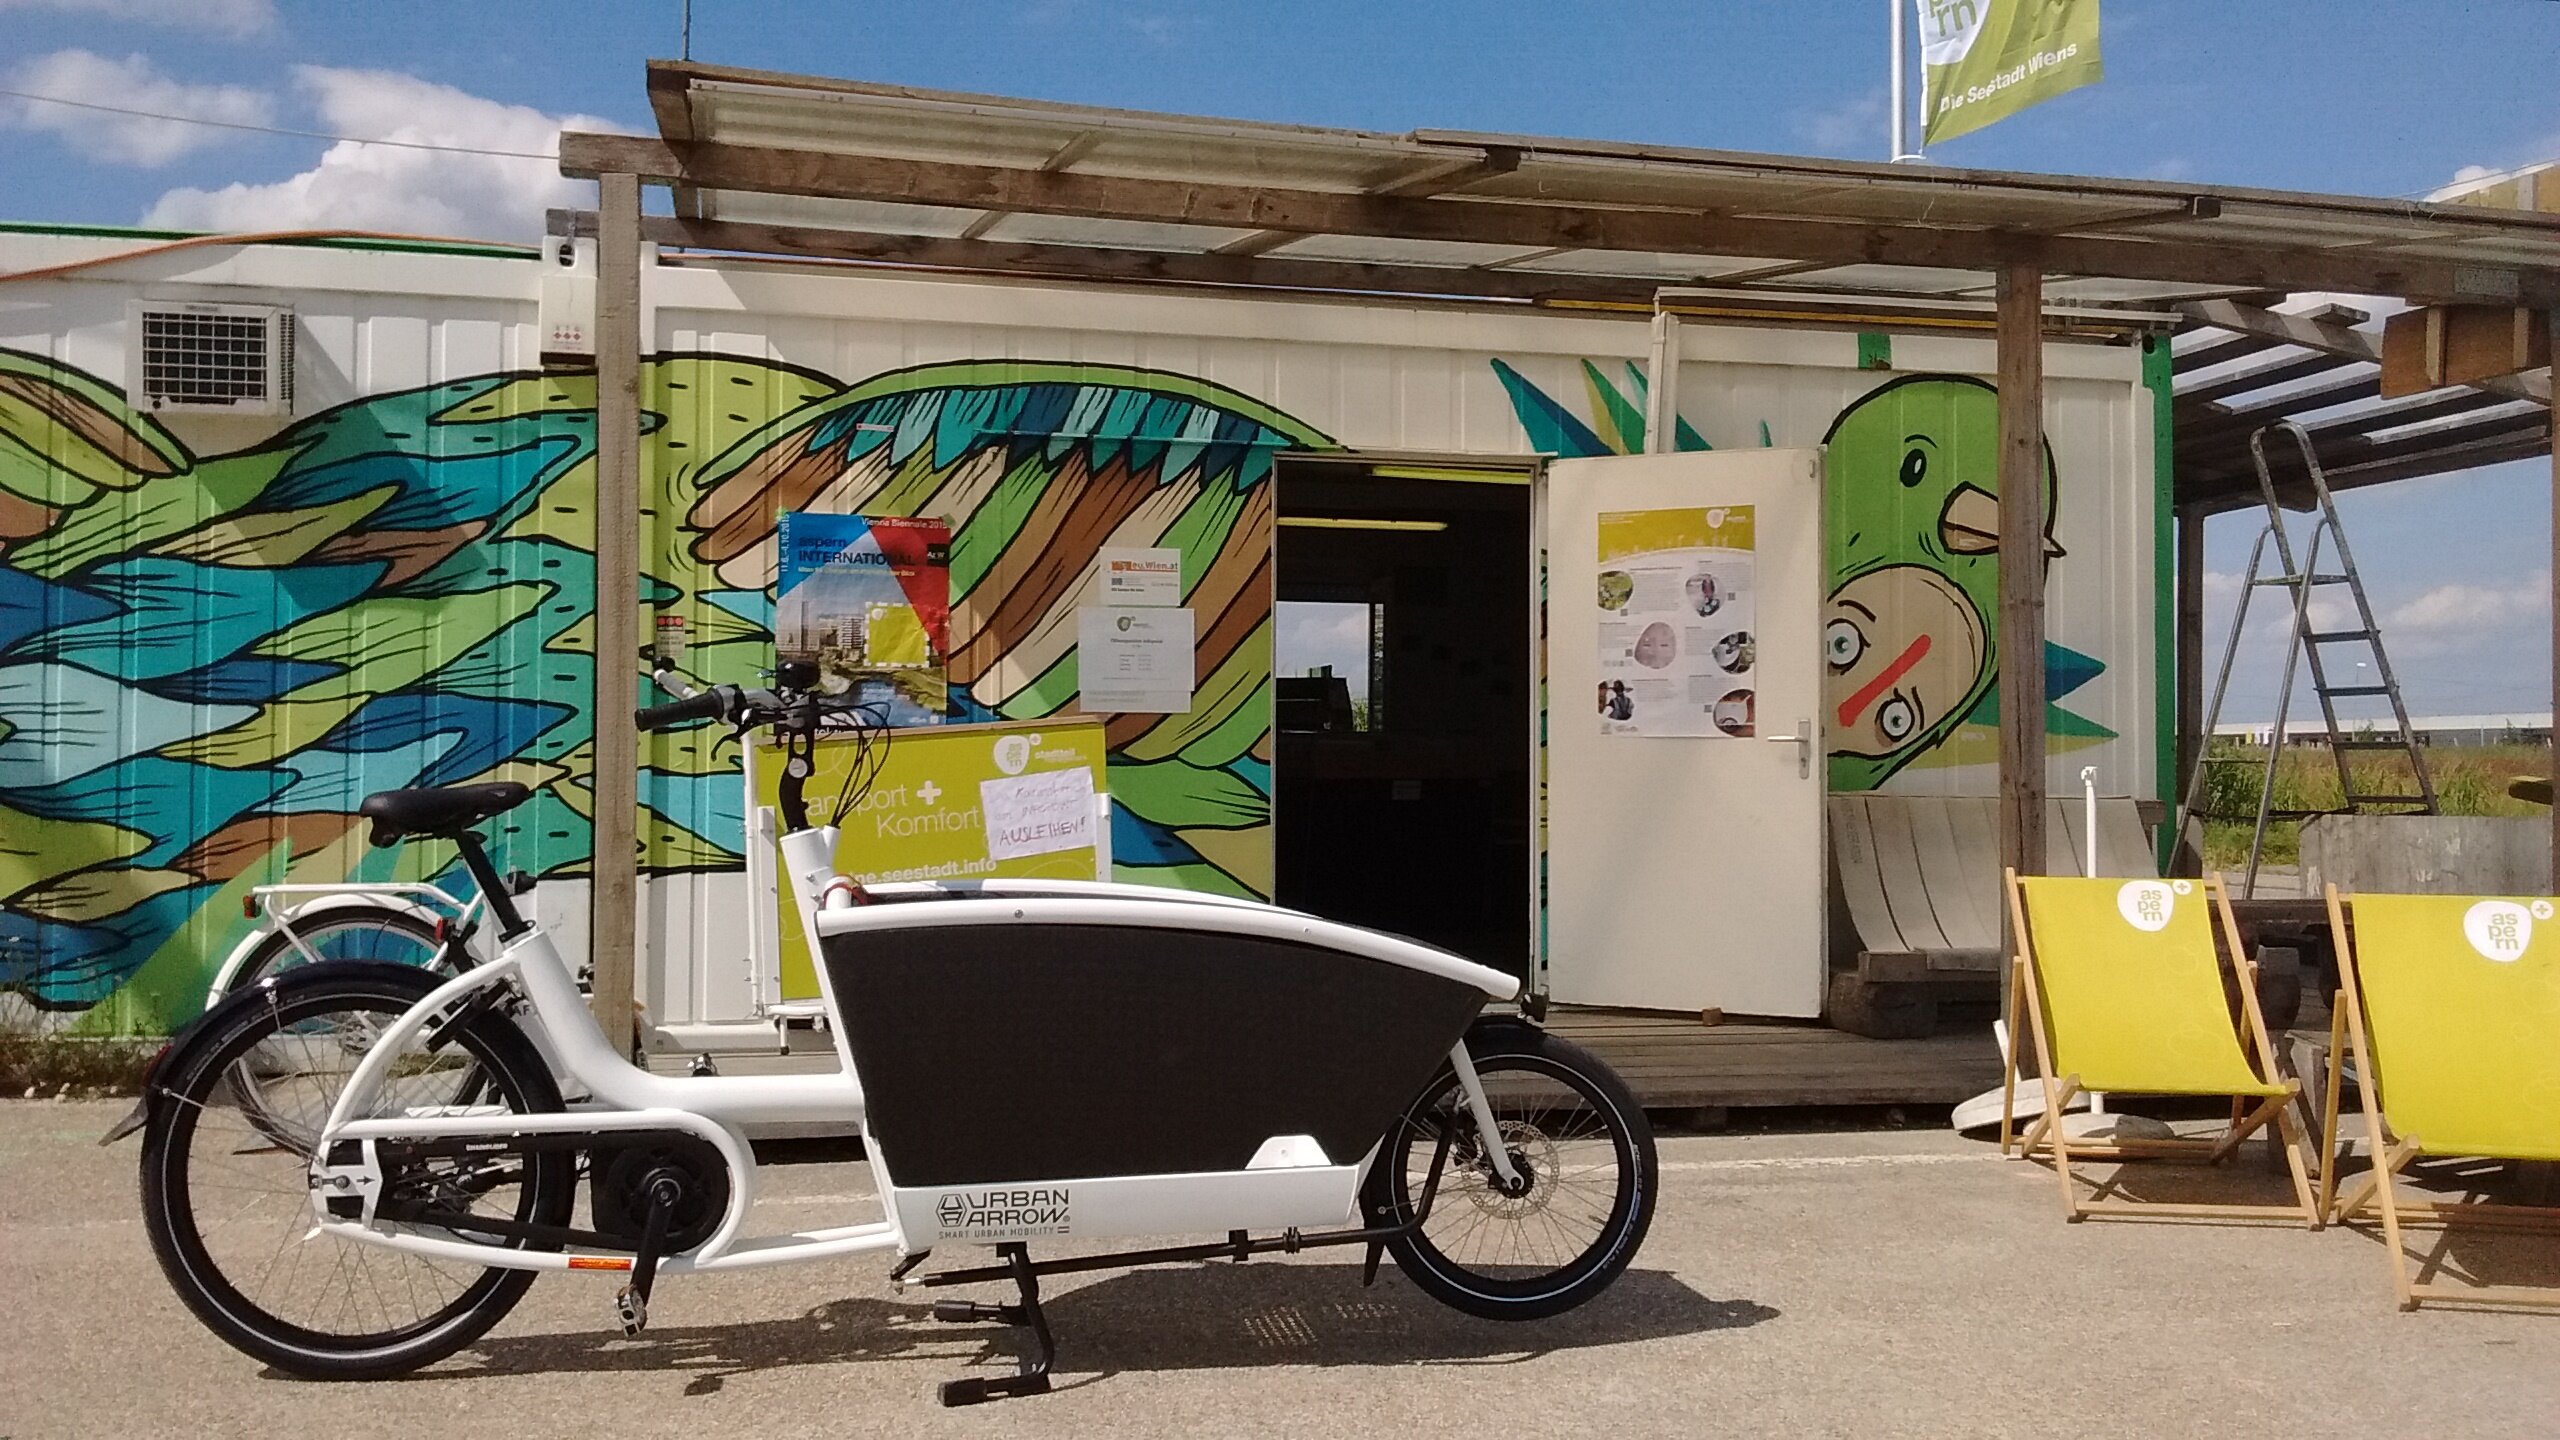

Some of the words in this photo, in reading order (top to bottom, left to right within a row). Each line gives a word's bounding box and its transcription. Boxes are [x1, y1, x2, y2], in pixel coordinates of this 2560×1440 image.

[1940, 93, 1964, 113] Die
[1967, 64, 2026, 103] Seestadt
[2028, 43, 2078, 74] Wiens
[798, 536, 847, 549] aspern
[799, 549, 917, 567] INTERNATIONAL
[876, 806, 980, 838] Komfort
[999, 816, 1086, 846] AUSLEIHEN!
[966, 1189, 1070, 1209] URBAN
[966, 1207, 1070, 1227] ARROW
[938, 1230, 969, 1240] SMART
[974, 1228, 1005, 1238] URBAN
[1010, 1227, 1054, 1237] MOBILITY
